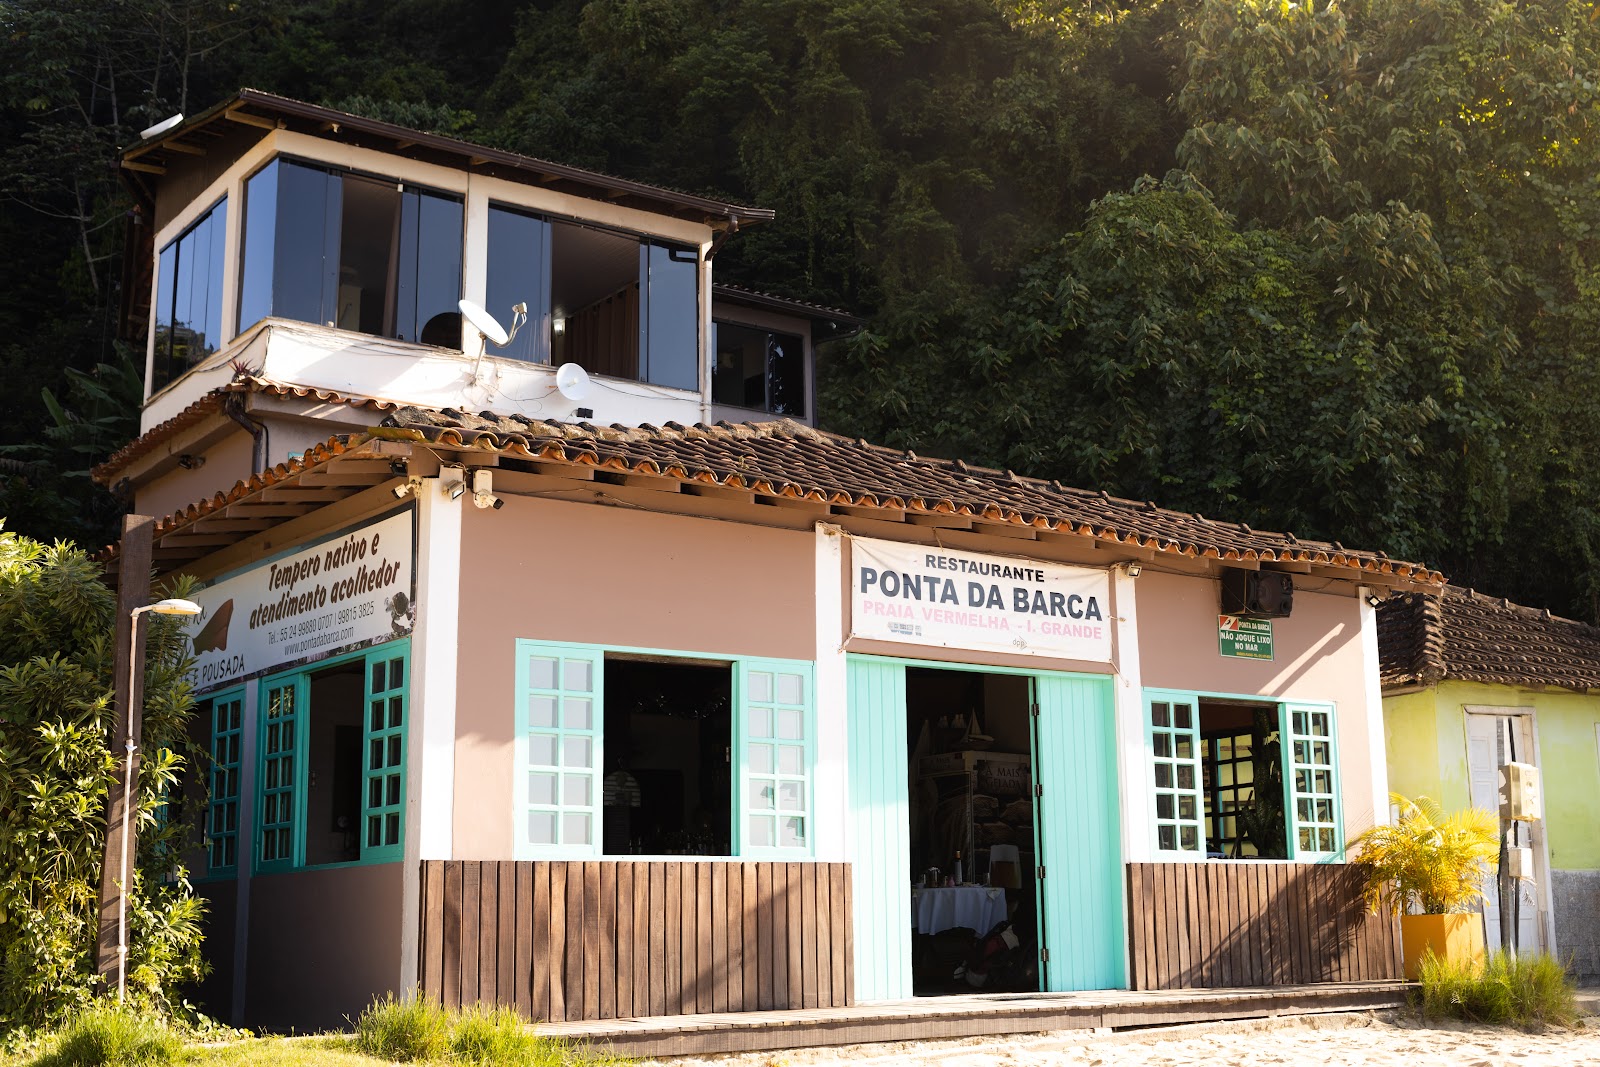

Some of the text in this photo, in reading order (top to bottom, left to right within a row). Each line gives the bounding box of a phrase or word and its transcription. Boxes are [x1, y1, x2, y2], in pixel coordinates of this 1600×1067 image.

[269, 533, 380, 592] Tempero nativo e
[925, 554, 1045, 582] RESTAURANTE
[250, 584, 327, 630] atendimento
[331, 558, 400, 604] acolhedor
[860, 567, 1102, 621] PONTA DA BARCA
[280, 627, 288, 642] 55
[289, 625, 297, 639] 24
[317, 613, 333, 631] 0707
[337, 606, 357, 624] 99815
[358, 601, 375, 618] 3825
[863, 600, 915, 619] PRAIA
[922, 607, 1010, 631] VERMELHA
[1041, 621, 1102, 640] GRANDE
[284, 626, 354, 656] www.pontadabarca.com
[1221, 631, 1271, 644] NÃO JOGUE LIXO
[1235, 642, 1243, 650] NO
[202, 653, 245, 683] POUSADA
[997, 768, 1020, 777] MAIS
